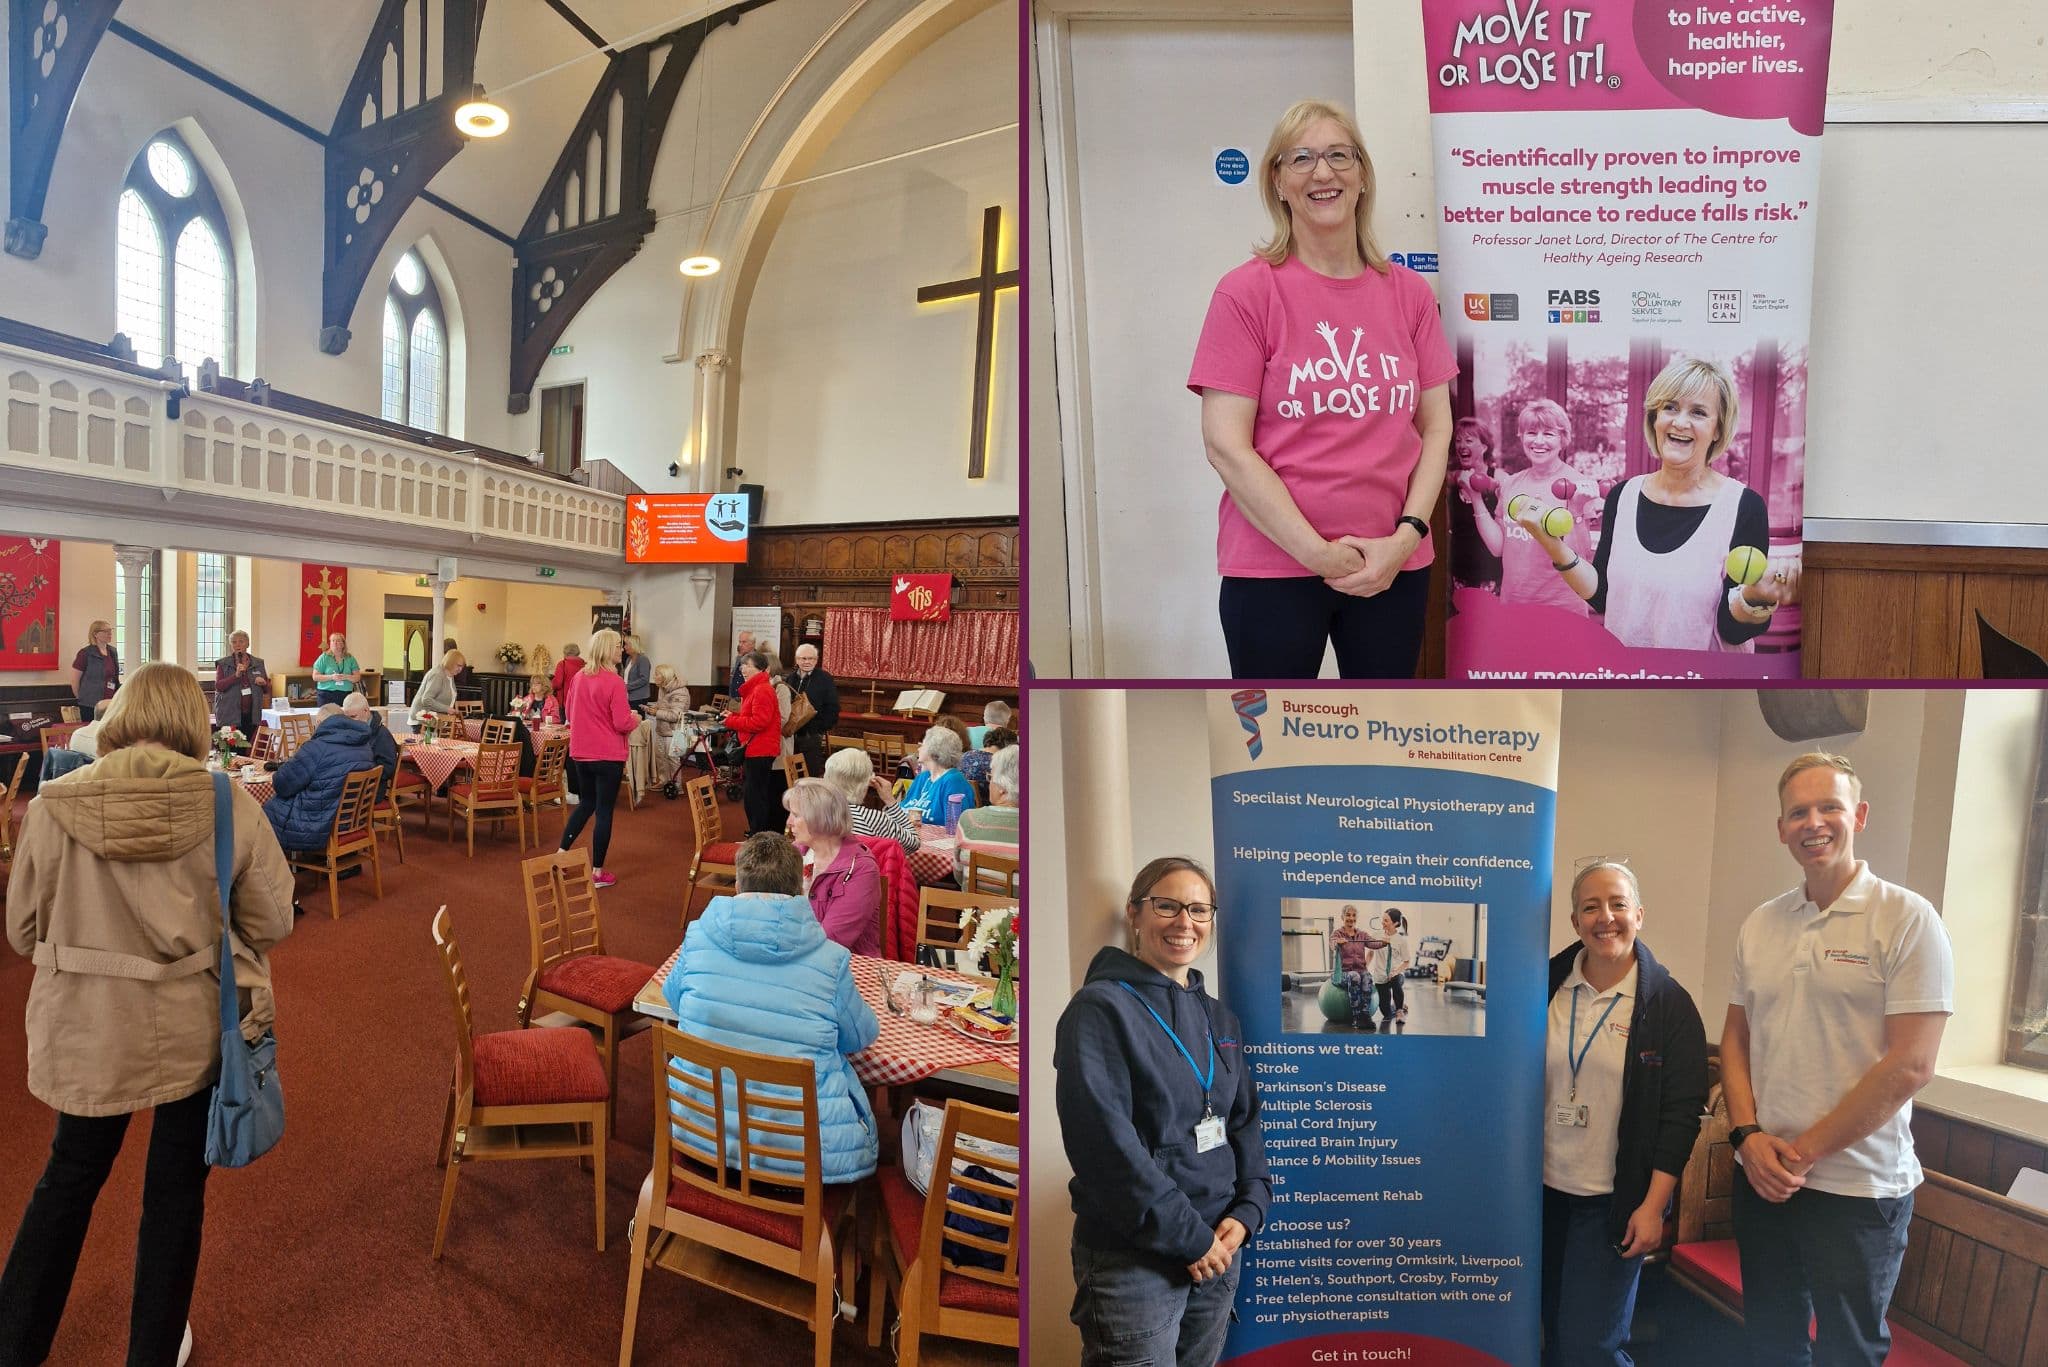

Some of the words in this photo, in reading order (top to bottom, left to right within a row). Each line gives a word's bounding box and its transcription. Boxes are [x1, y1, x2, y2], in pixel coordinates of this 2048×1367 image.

[1668, 9, 1691, 26] to
[1696, 7, 1732, 25] live
[1736, 4, 1806, 25] active,
[1453, 0, 1549, 58] MOVE
[1563, 9, 1591, 44] IT
[1688, 30, 1785, 50] healthier,
[1439, 63, 1469, 87] OR
[1479, 47, 1557, 90] LOSE
[1569, 43, 1604, 88] IT!
[1668, 56, 1747, 80] happier
[1752, 55, 1804, 73] lives.
[1604, 149, 1679, 171] proven
[1684, 145, 1707, 165] to
[1712, 145, 1801, 168] improve
[1482, 177, 1555, 196] muscle
[1560, 175, 1653, 199] strength
[1658, 174, 1737, 198] leading
[1743, 175, 1767, 193] to
[1444, 205, 1504, 224] better
[1510, 204, 1592, 224] balance
[1596, 205, 1620, 222] to
[1625, 203, 1697, 222] reduce
[1702, 202, 1748, 222] falls
[1473, 234, 1532, 246] Professor
[1534, 233, 1572, 246] Janet
[1576, 233, 1606, 247] Lord,
[1611, 233, 1661, 245] Director
[1665, 233, 1680, 245] of
[1684, 233, 1707, 245] The
[1711, 233, 1754, 245] Centre
[1758, 232, 1778, 245] for
[1543, 252, 1593, 266] Healthy
[1597, 252, 1640, 266] Ageing
[1644, 251, 1703, 264] Research
[1548, 289, 1600, 305] FABS
[1632, 291, 1661, 300] ROYAL
[1632, 297, 1682, 307] VOLUNTARY
[1712, 293, 1737, 301] THIS
[1469, 298, 1485, 310] UK
[1631, 307, 1662, 315] SERVICE
[1288, 320, 1371, 395] MOVE
[1379, 353, 1399, 380] IT
[1277, 400, 1305, 418] OR
[1313, 383, 1381, 418] LOSE
[1389, 380, 1414, 415] IT!
[1282, 700, 1359, 717] Burscough
[1282, 717, 1359, 740] Neuro
[1368, 721, 1540, 752] Physiotherapy
[1408, 751, 1415, 759] &
[1418, 750, 1486, 762] Rehabilitation
[1489, 752, 1522, 763] Centre
[1233, 791, 1302, 807] Specilaist
[1306, 794, 1399, 811] Neurological
[1404, 798, 1504, 815] Physiotherapy
[1508, 802, 1535, 815] and
[1338, 816, 1433, 832] Rehabiliation
[1233, 847, 1290, 864] Helping
[1294, 850, 1344, 866] people
[1348, 852, 1363, 863] to
[1366, 853, 1412, 869] regain
[1415, 854, 1449, 867] their
[1452, 855, 1534, 871] confidence,
[1282, 870, 1386, 887] independence
[1389, 873, 1416, 886] and
[1420, 875, 1482, 889] mobility!
[1243, 1043, 1315, 1055] onditions
[1319, 1045, 1340, 1055] we
[1344, 1043, 1383, 1055] treat:
[1255, 1063, 1299, 1074] Stroke
[1337, 1081, 1386, 1093] Disease
[1315, 1099, 1373, 1112] Sclerosis
[1301, 1118, 1333, 1130] Cord
[1338, 1118, 1377, 1132] Injury
[1264, 1137, 1317, 1150] cquired
[1320, 1136, 1354, 1147] Brain
[1359, 1136, 1398, 1150] Injury
[1266, 1155, 1308, 1166] alance
[1312, 1154, 1320, 1165] &
[1325, 1154, 1378, 1168] Mobility
[1382, 1154, 1421, 1165] Issues
[1294, 1191, 1379, 1205] Replacement
[1383, 1190, 1423, 1202] Rehab
[1270, 1219, 1323, 1231] choose
[1327, 1219, 1351, 1231] us?
[1256, 1238, 1331, 1251] Established
[1334, 1238, 1352, 1249] for
[1357, 1239, 1385, 1248] over
[1389, 1237, 1404, 1247] 30
[1408, 1238, 1441, 1250] years
[1256, 1257, 1295, 1269] Home
[1299, 1256, 1333, 1268] visits
[1336, 1255, 1393, 1270] covering
[1396, 1254, 1457, 1268] Ormksirk,
[1462, 1254, 1524, 1269] Liverpool,
[1255, 1275, 1269, 1287] St
[1327, 1273, 1395, 1288] Southport,
[1399, 1272, 1447, 1286] Crosby,
[1451, 1272, 1499, 1286] Formby
[1256, 1294, 1284, 1305] Free
[1288, 1292, 1353, 1306] telephone
[1357, 1291, 1437, 1303] consultation
[1440, 1290, 1468, 1302] with
[1472, 1293, 1495, 1302] one
[1499, 1290, 1512, 1302] of
[1255, 1313, 1278, 1323] our
[1282, 1309, 1389, 1323] physiotherapists
[1312, 1349, 1338, 1362] Get
[1343, 1349, 1357, 1361] in
[1362, 1347, 1411, 1361] touch!
